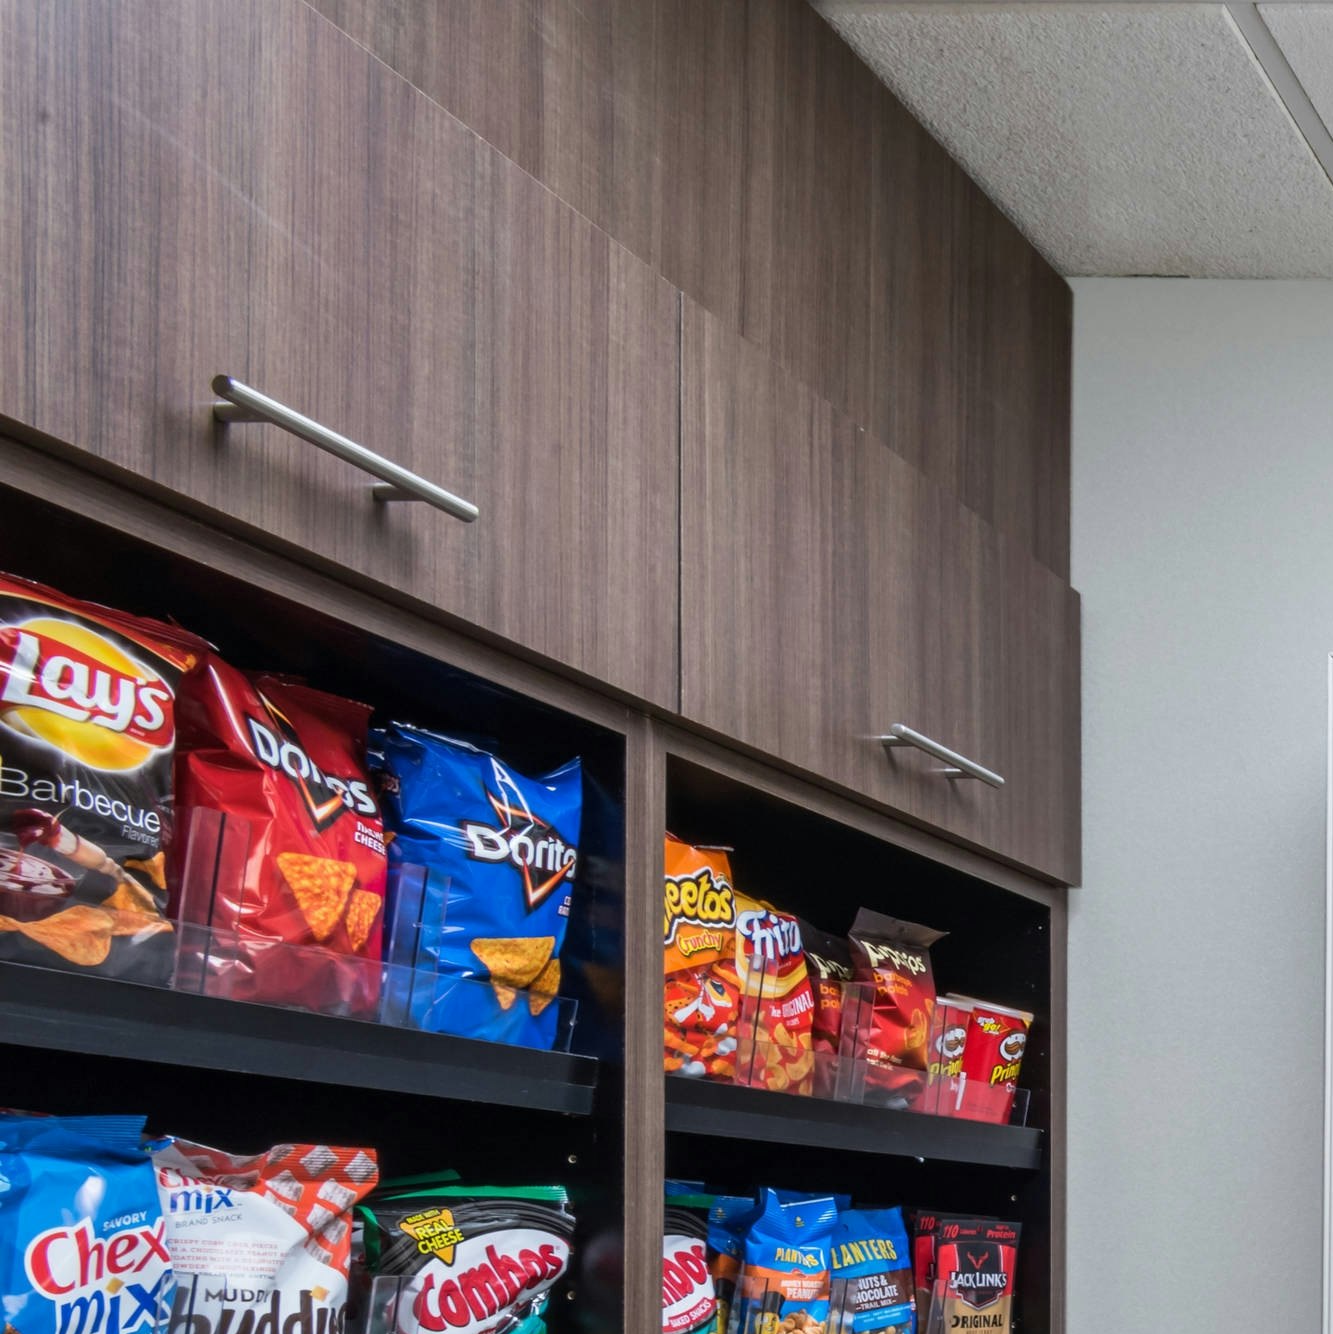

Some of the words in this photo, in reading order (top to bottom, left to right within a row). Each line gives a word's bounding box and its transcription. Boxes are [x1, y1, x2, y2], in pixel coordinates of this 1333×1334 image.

[2, 631, 170, 732] Lay's
[0, 766, 162, 833] Barbecue
[465, 823, 577, 879] Dorito
[677, 930, 723, 956] Crunchy
[736, 910, 802, 971] Frito
[170, 1188, 235, 1214] mix
[103, 1211, 148, 1232] SAVORY
[175, 1217, 209, 1229] BRAND
[211, 1213, 243, 1224] SNACK
[414, 1219, 453, 1240] REAL
[943, 1224, 960, 1239] 110
[417, 1229, 465, 1255] CHEESE
[986, 1229, 1017, 1240] Protein
[30, 1221, 171, 1295] Chex
[830, 1238, 898, 1270] LANTERS
[412, 1243, 564, 1332] Combos
[856, 1285, 899, 1304] HOCOLATE
